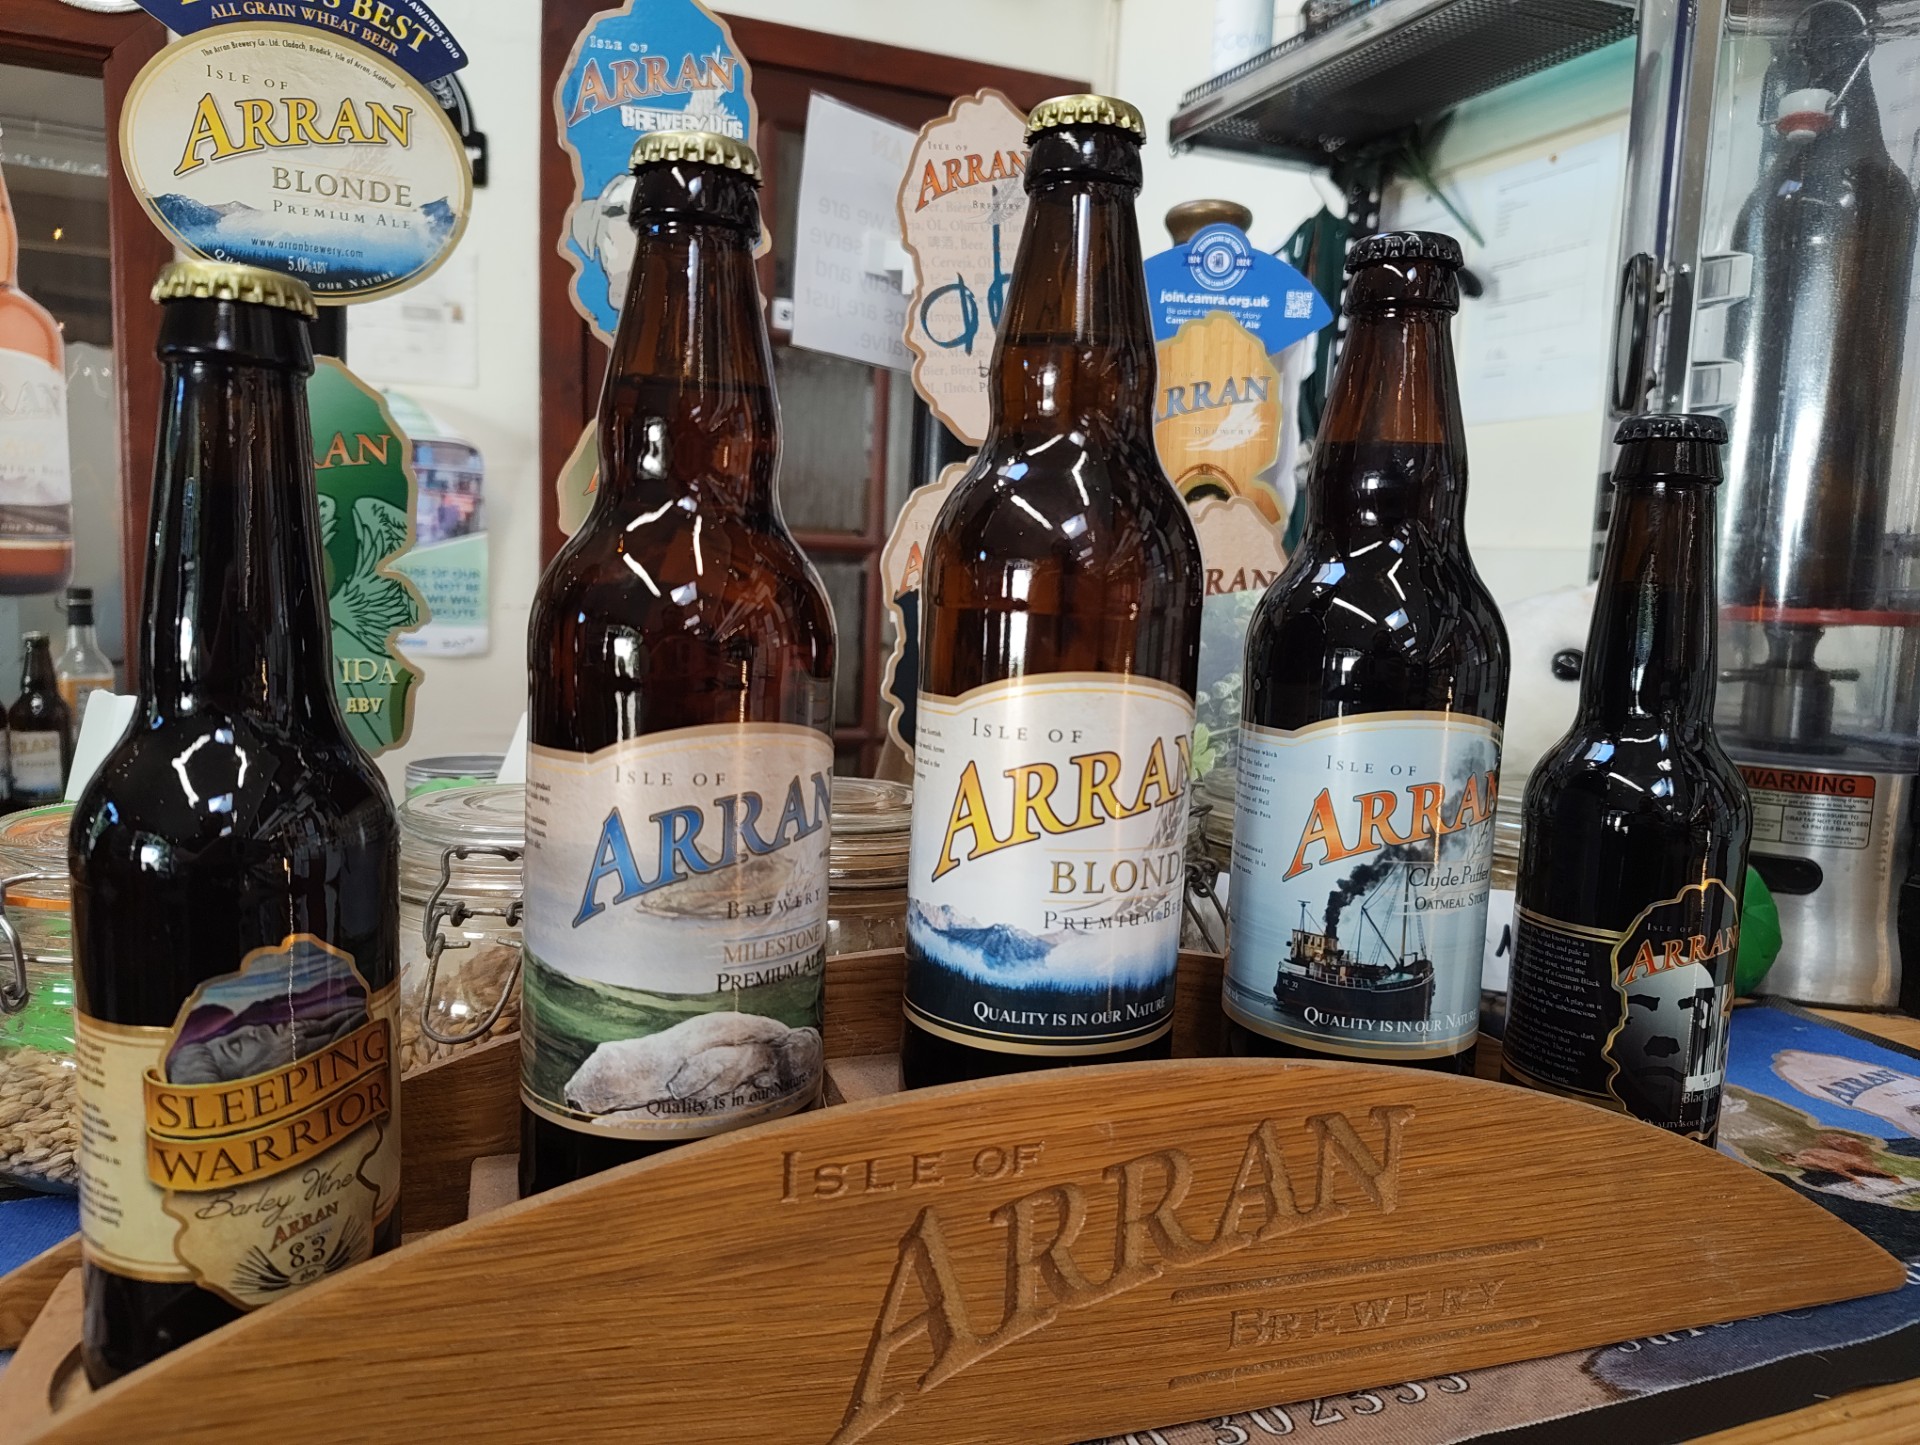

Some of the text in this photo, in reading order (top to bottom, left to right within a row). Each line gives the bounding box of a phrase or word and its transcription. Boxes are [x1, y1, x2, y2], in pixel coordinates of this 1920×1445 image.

[211, 1, 400, 57] ALL GRAIN WHEAT BEER
[350, 0, 434, 52] BEST
[408, 3, 444, 38] AWARDS
[440, 34, 460, 59] 2010
[201, 48, 213, 57] The
[213, 44, 231, 53] Arran
[231, 40, 256, 49] Brewery
[590, 36, 648, 53] ISLE OF
[206, 64, 289, 90] ISLE OF
[567, 53, 738, 128] ARRAN
[173, 92, 414, 177] ARRAN
[621, 105, 744, 139] BREWERY DUG
[272, 166, 412, 208] BLONDE
[915, 150, 1031, 212] ARRAN
[273, 199, 411, 230] PREMIUM ALE
[350, 270, 396, 289] NATURE
[1160, 288, 1269, 308] join.camra.org.uk
[1205, 566, 1278, 596] RAN
[341, 657, 398, 685] IPA
[345, 697, 382, 714] ABV
[972, 717, 1084, 743] ISLE OF
[615, 766, 727, 787] ISLE OF
[1326, 755, 1418, 777] ISLE OF
[1742, 769, 1856, 795] WARNING
[931, 734, 1192, 883] ARRAN
[572, 767, 832, 929] ARRAN
[1409, 866, 1459, 890] Clyde
[727, 887, 822, 920] BREWERY
[1044, 900, 1181, 930] PREMIUM BEE
[1414, 896, 1466, 911] OATMEAL
[723, 923, 821, 964] MILESTONE
[1647, 922, 1672, 933] ISLE
[1621, 925, 1739, 987] ARRAN
[716, 962, 797, 992] PREMIUM
[973, 995, 1167, 1027] QUALITY IS IN OUR NATURE
[1303, 1006, 1477, 1033] QUALITY IS IN OUR NATURE
[156, 1028, 387, 1130] SLEEPING
[1817, 1069, 1905, 1106] ARRAN
[646, 1096, 712, 1118] Quality
[714, 1095, 727, 1110] is
[731, 1094, 745, 1108] in
[749, 1087, 772, 1103] our
[1683, 1092, 1709, 1104] Black
[154, 1084, 388, 1184] WARRIOR
[781, 1140, 1046, 1203] ISLE OF
[196, 1165, 355, 1229] Barley Wine
[269, 1201, 339, 1253] ARRAN
[289, 1235, 326, 1268] 8.3
[824, 1104, 1417, 1445] ARRAN
[1228, 1278, 1506, 1351] BREWERY
